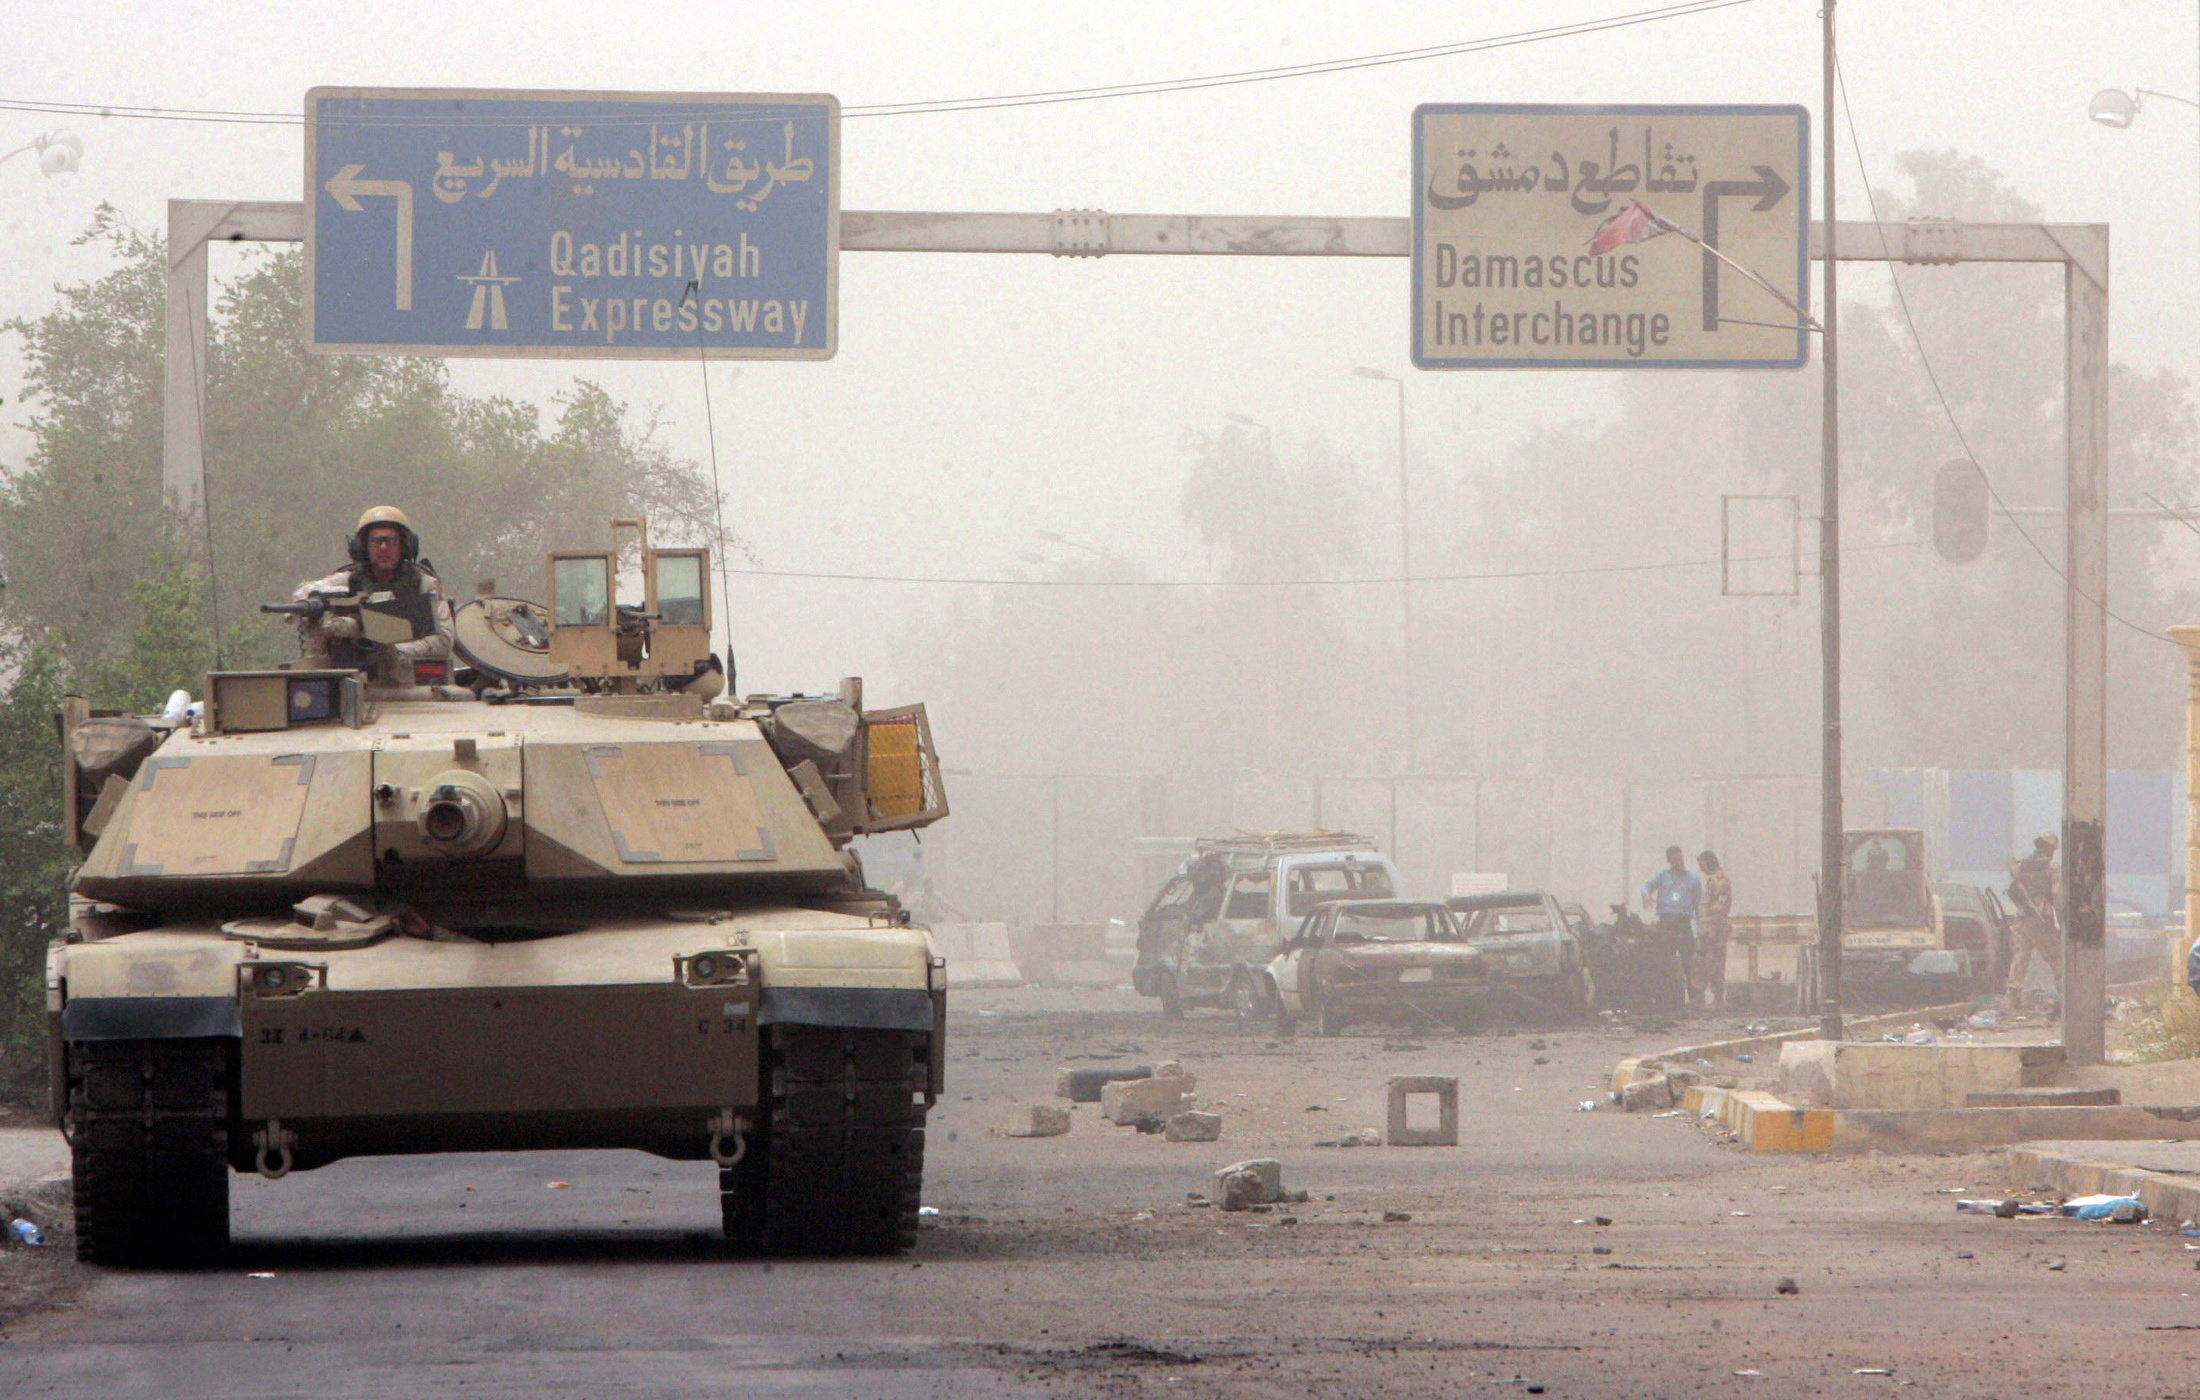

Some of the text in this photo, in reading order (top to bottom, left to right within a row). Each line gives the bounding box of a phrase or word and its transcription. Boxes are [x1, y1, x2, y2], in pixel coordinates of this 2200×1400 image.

[432, 121, 815, 213] طريق القادسية السريع
[1427, 126, 1699, 215] تقاطع دمشق
[549, 229, 760, 289] Qadisiyah
[1435, 243, 1640, 288] Damascus
[551, 285, 808, 344] Expressway
[1435, 300, 1671, 357] Interchange
